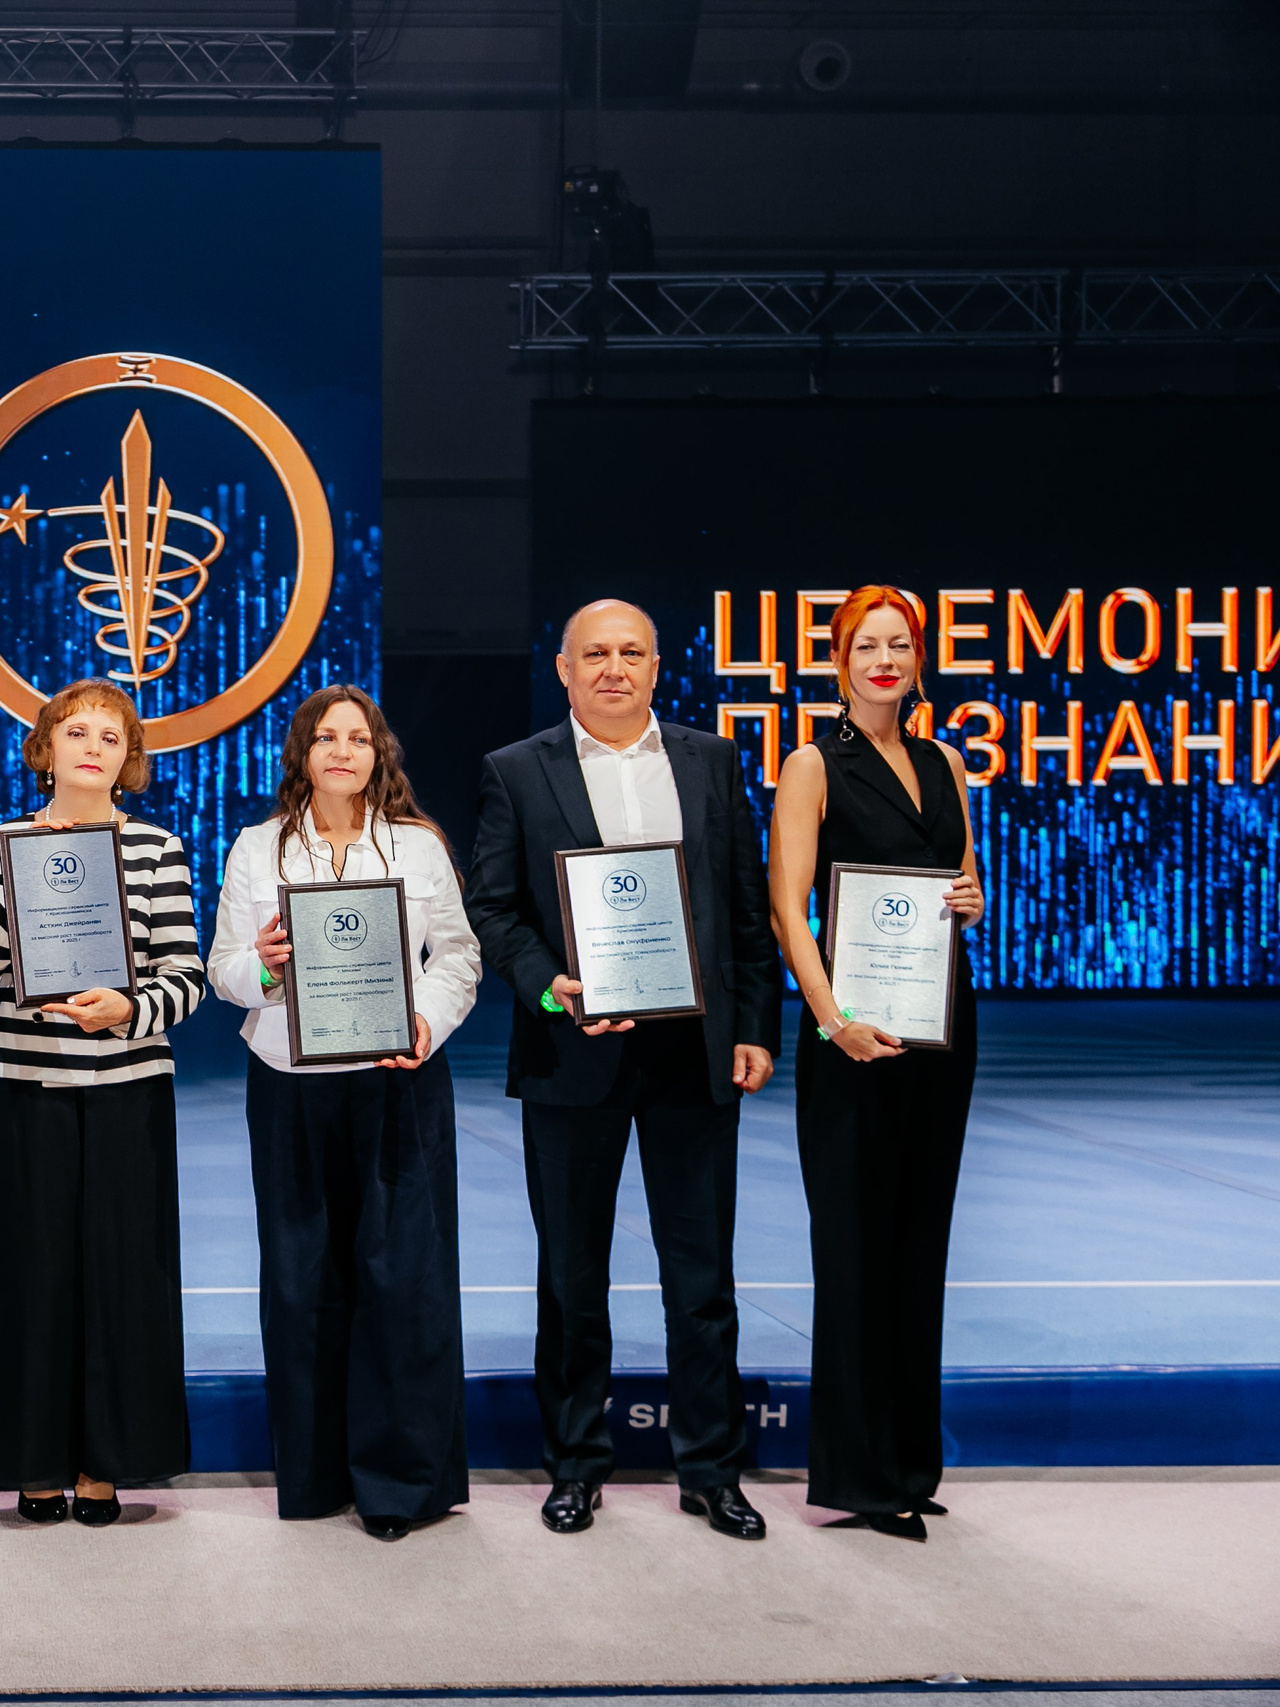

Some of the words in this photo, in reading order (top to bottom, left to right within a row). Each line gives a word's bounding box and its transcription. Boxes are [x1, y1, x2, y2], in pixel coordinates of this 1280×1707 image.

[714, 587, 1280, 694] ЦЕЕМОН
[51, 857, 77, 875] 30
[611, 876, 637, 893] 30
[882, 899, 909, 917] 30
[332, 914, 359, 932] 30
